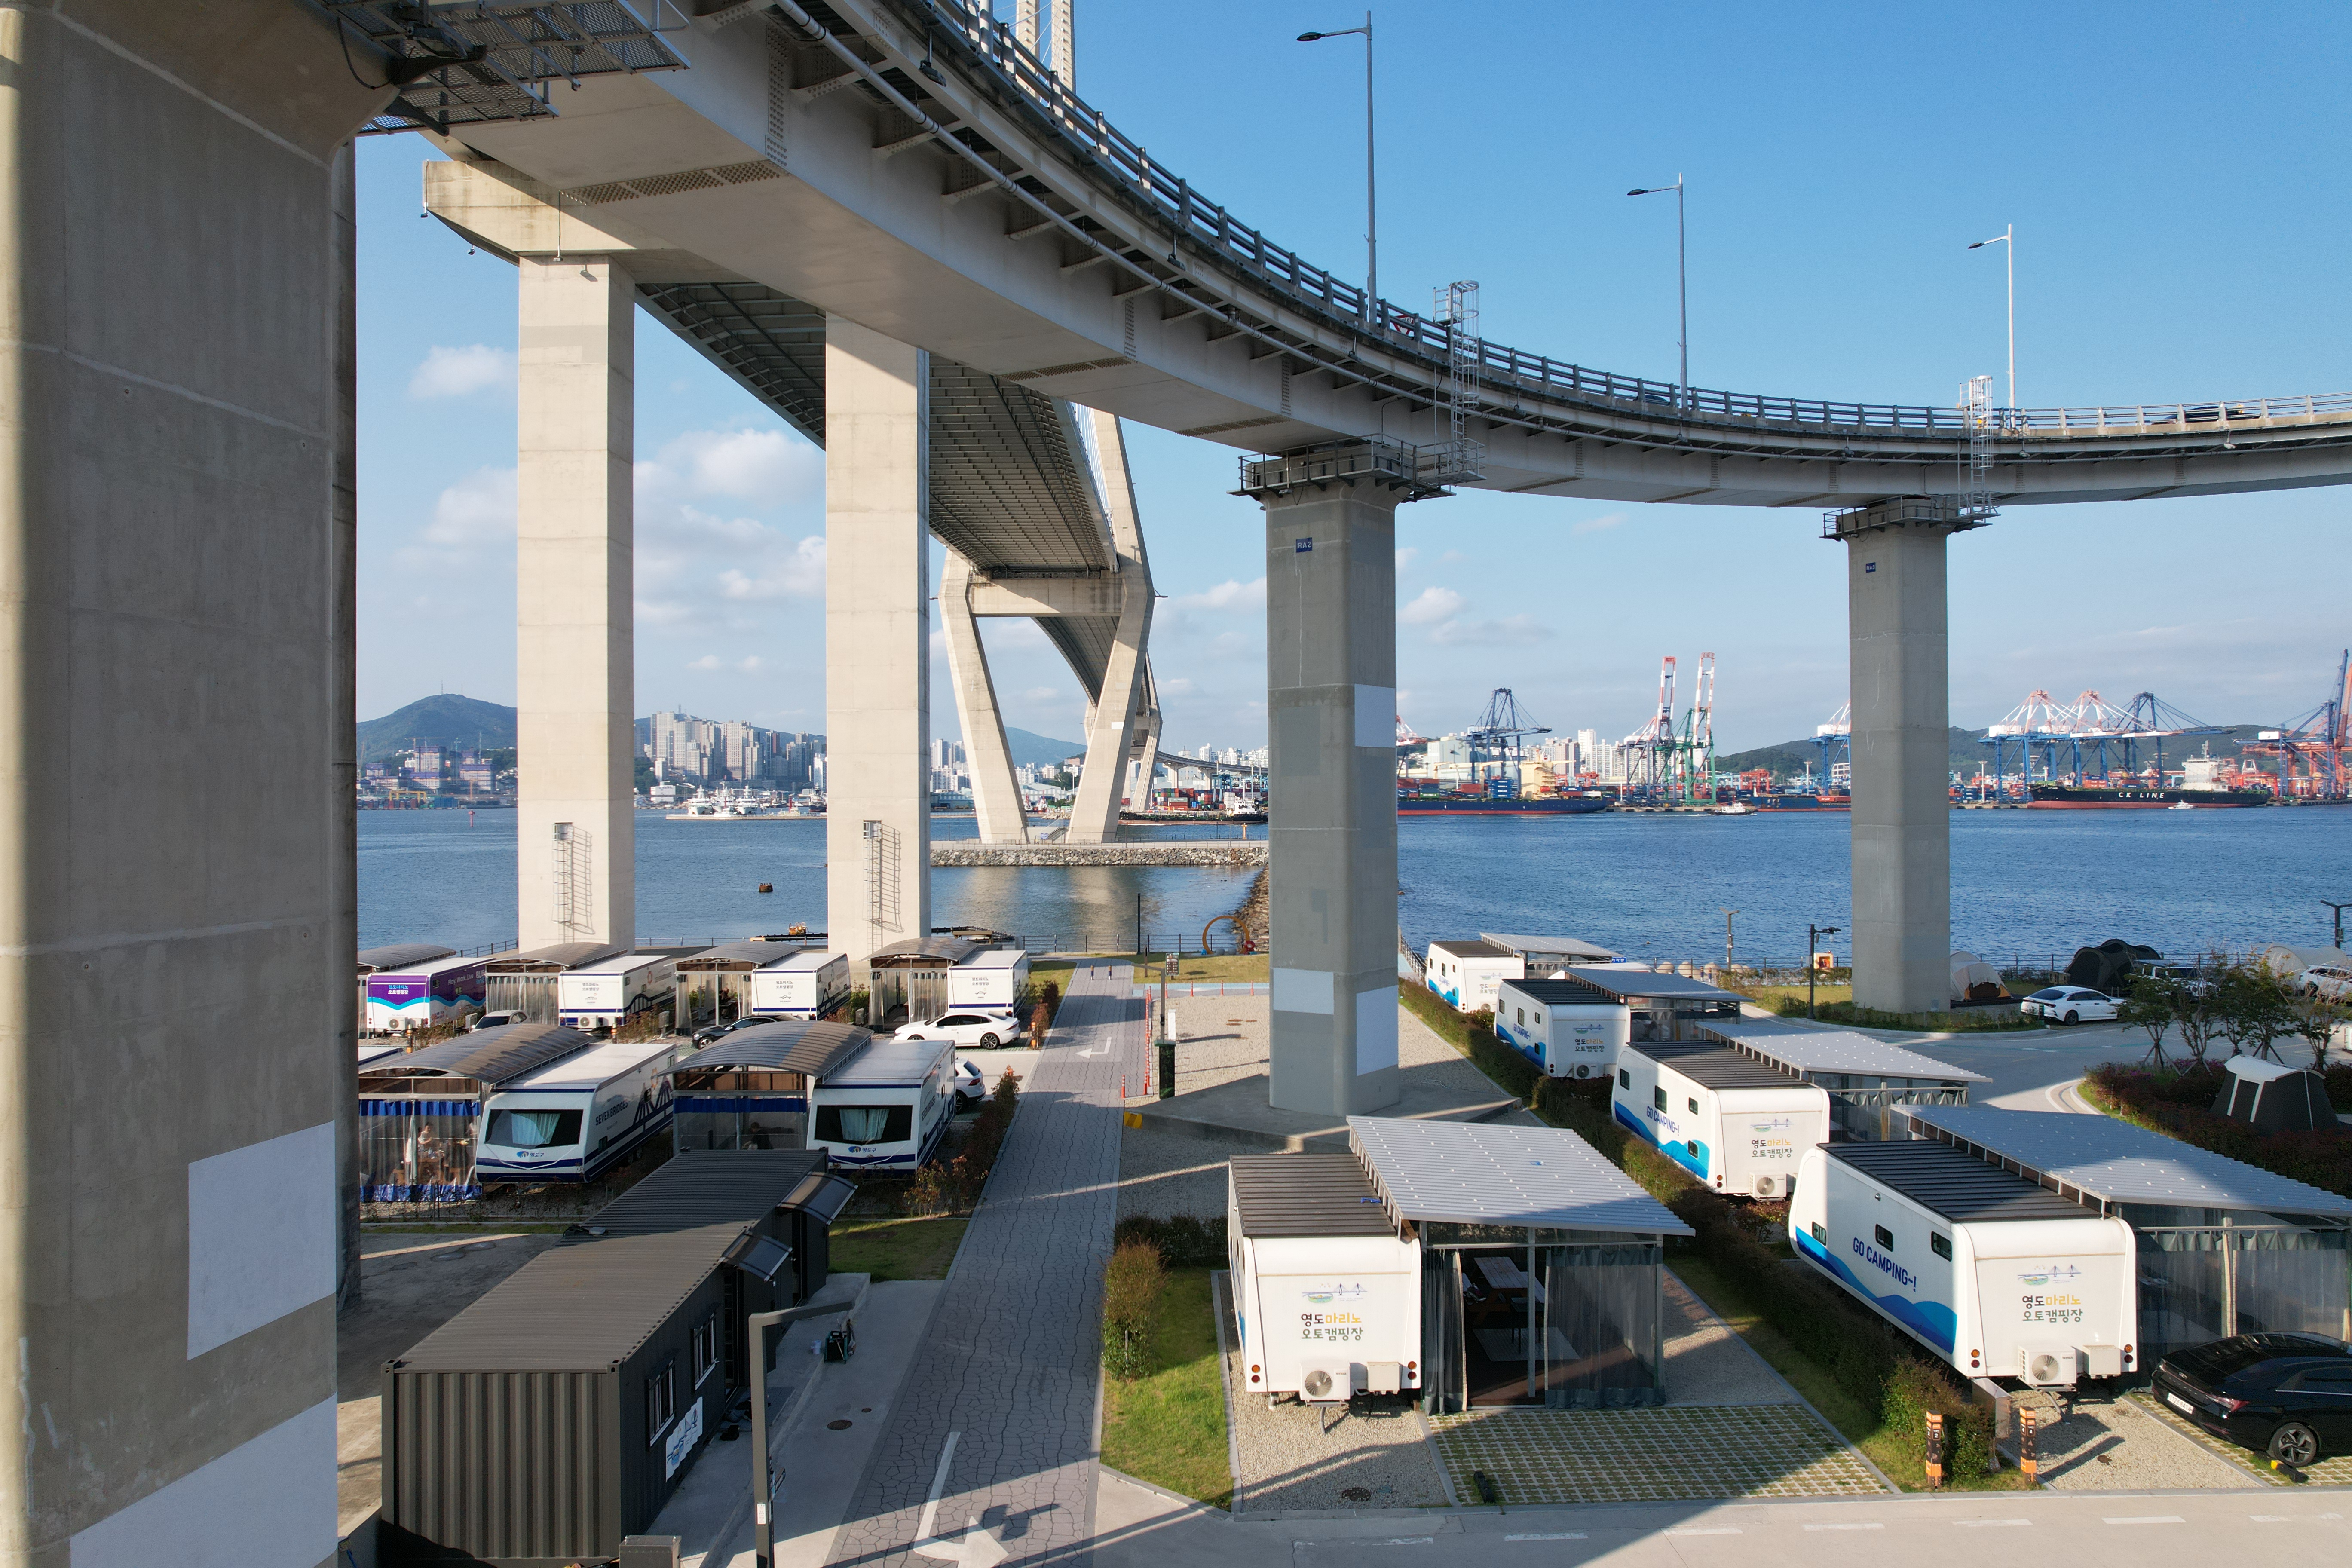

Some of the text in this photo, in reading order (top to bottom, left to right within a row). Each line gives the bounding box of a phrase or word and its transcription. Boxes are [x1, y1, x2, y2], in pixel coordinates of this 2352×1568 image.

[1647, 1106, 1653, 1119] GO
[1752, 1138, 1792, 1149] 영도마리노
[1752, 1148, 1793, 1158] 오토캠핑장
[1853, 1237, 1865, 1256] GO
[2022, 1294, 2081, 1309] 영도마리노
[1301, 1312, 1362, 1327] 영도마리노
[2022, 1308, 2083, 1323] 오토캠핑장
[1301, 1327, 1363, 1341] 오토캠핑장
